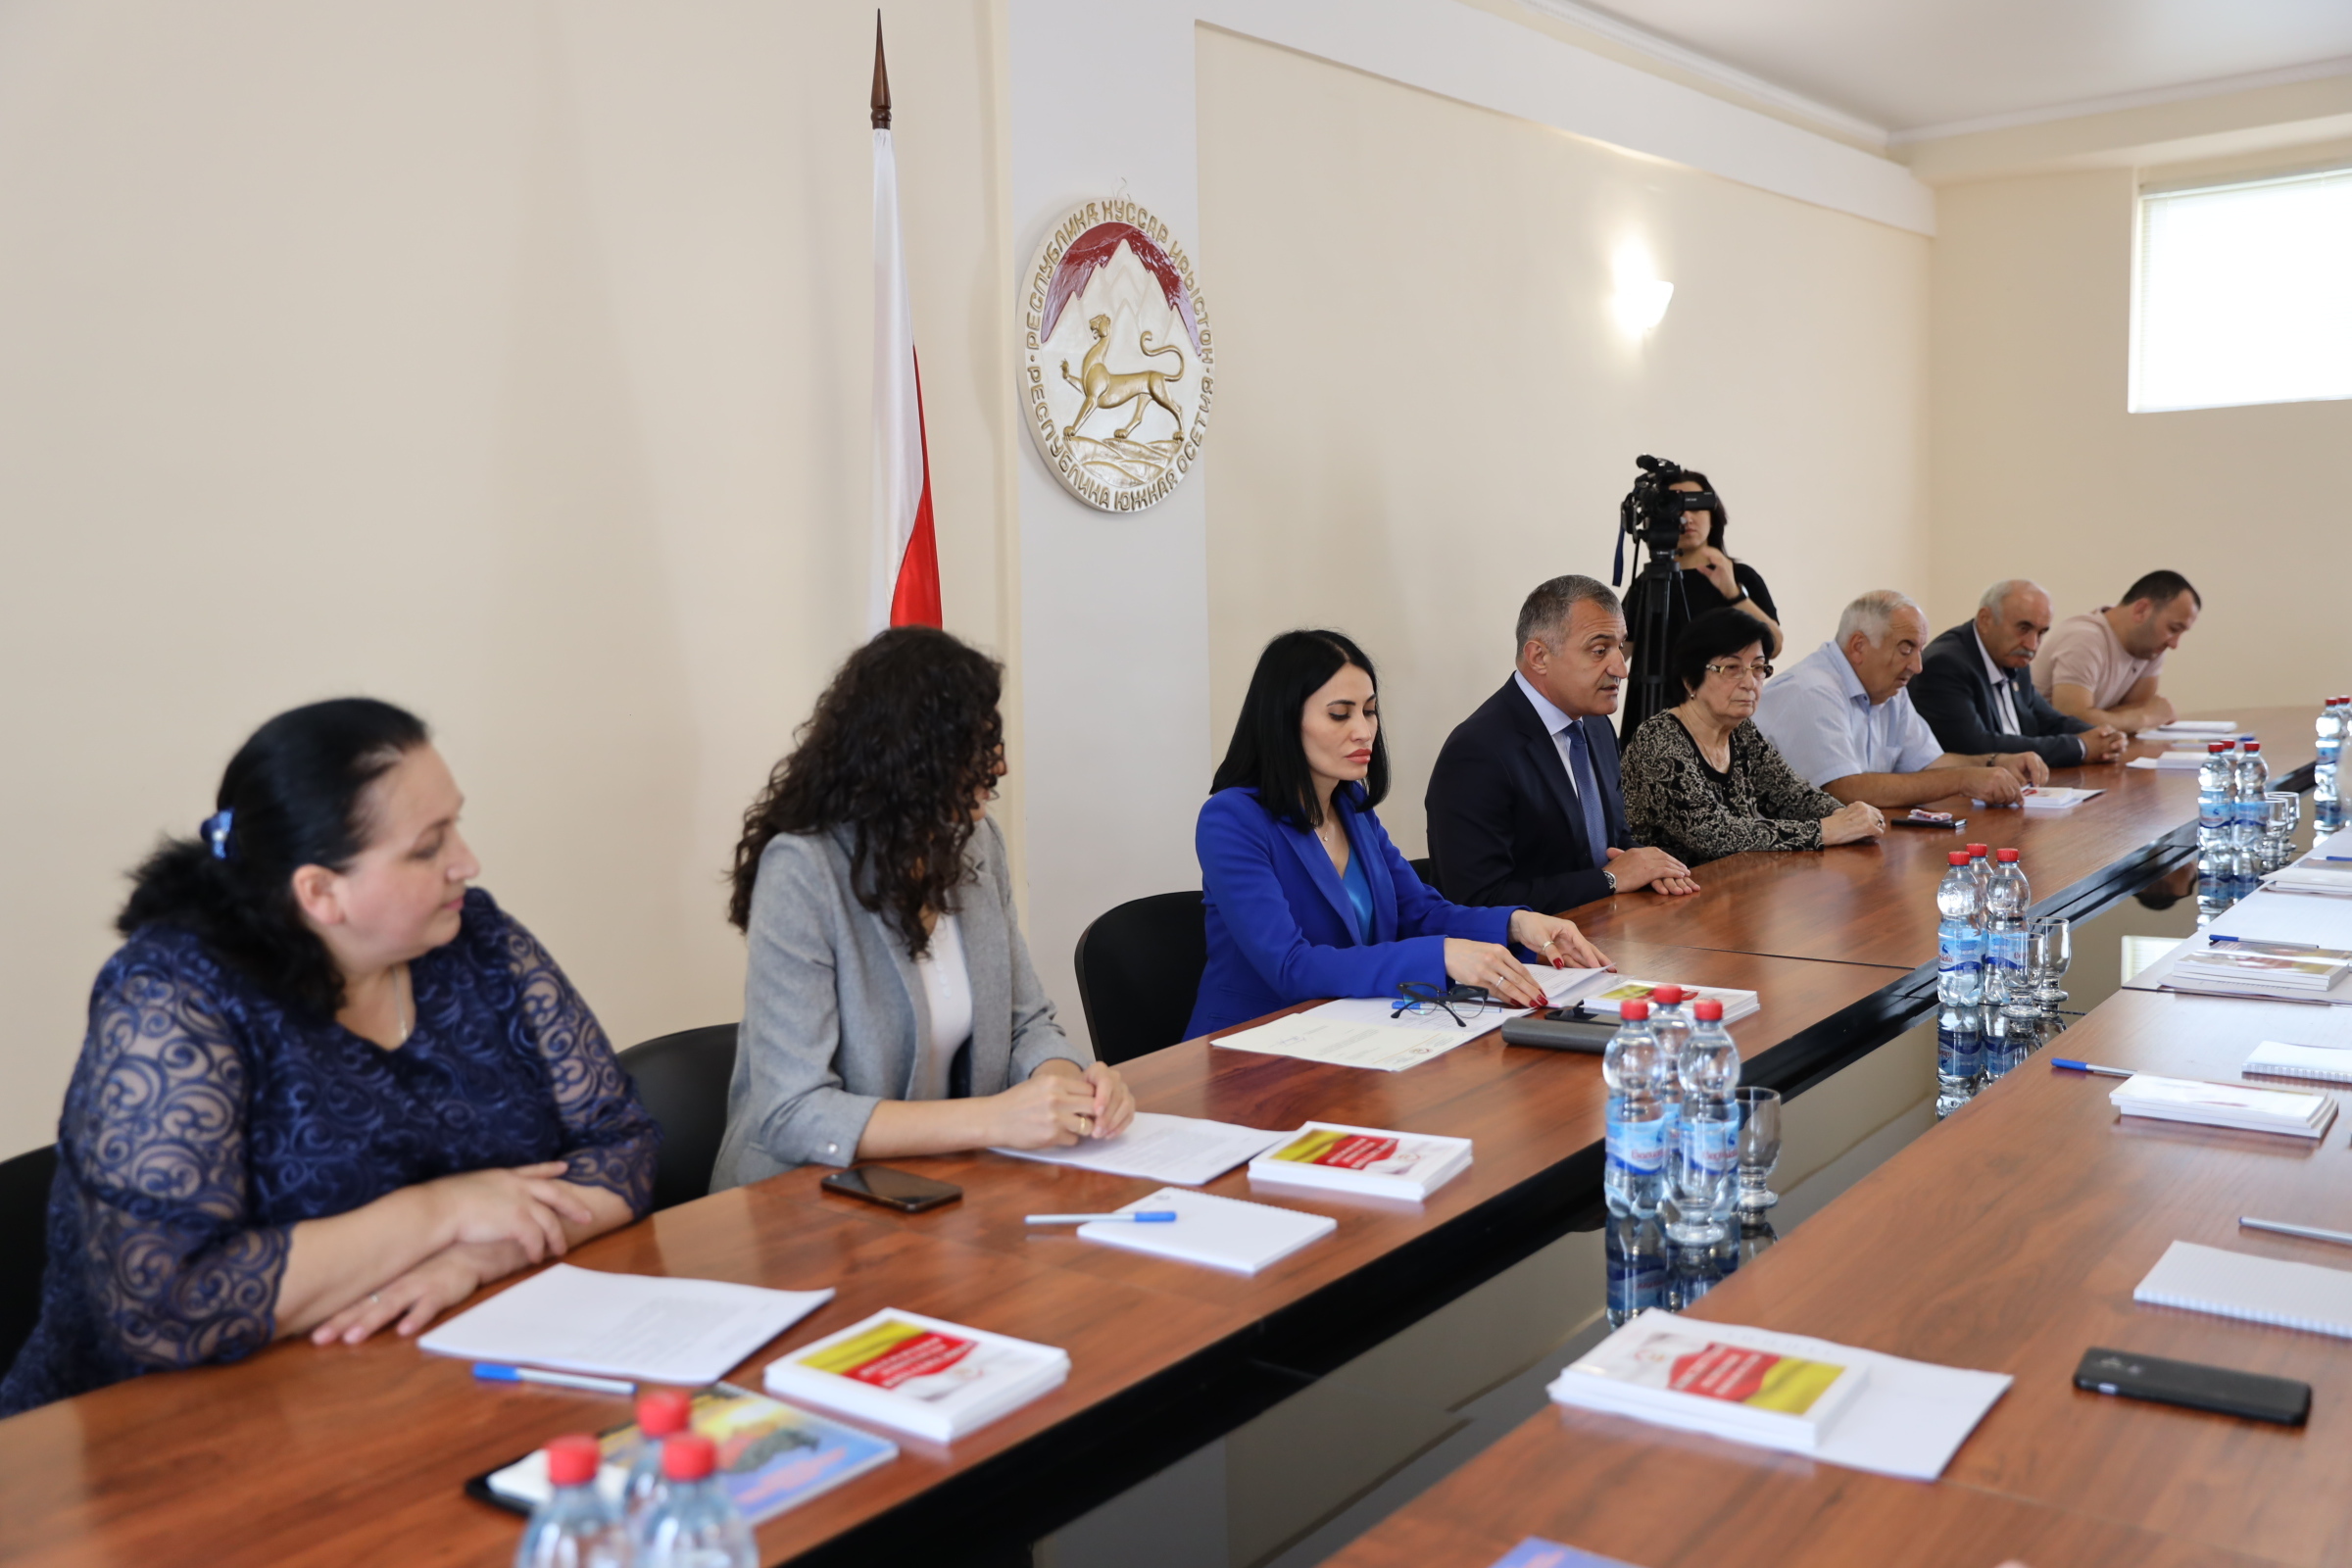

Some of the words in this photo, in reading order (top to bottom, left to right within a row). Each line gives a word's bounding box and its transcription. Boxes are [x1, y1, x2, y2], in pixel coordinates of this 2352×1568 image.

[1102, 199, 1169, 244] ХУССАР
[1169, 240, 1214, 365] ИРЫСТОН
[1027, 366, 1110, 509] РЕСПУБЛИКА
[1113, 468, 1179, 511] ЮЖНАЯ
[1176, 376, 1214, 474] ОСЕТИЯ
